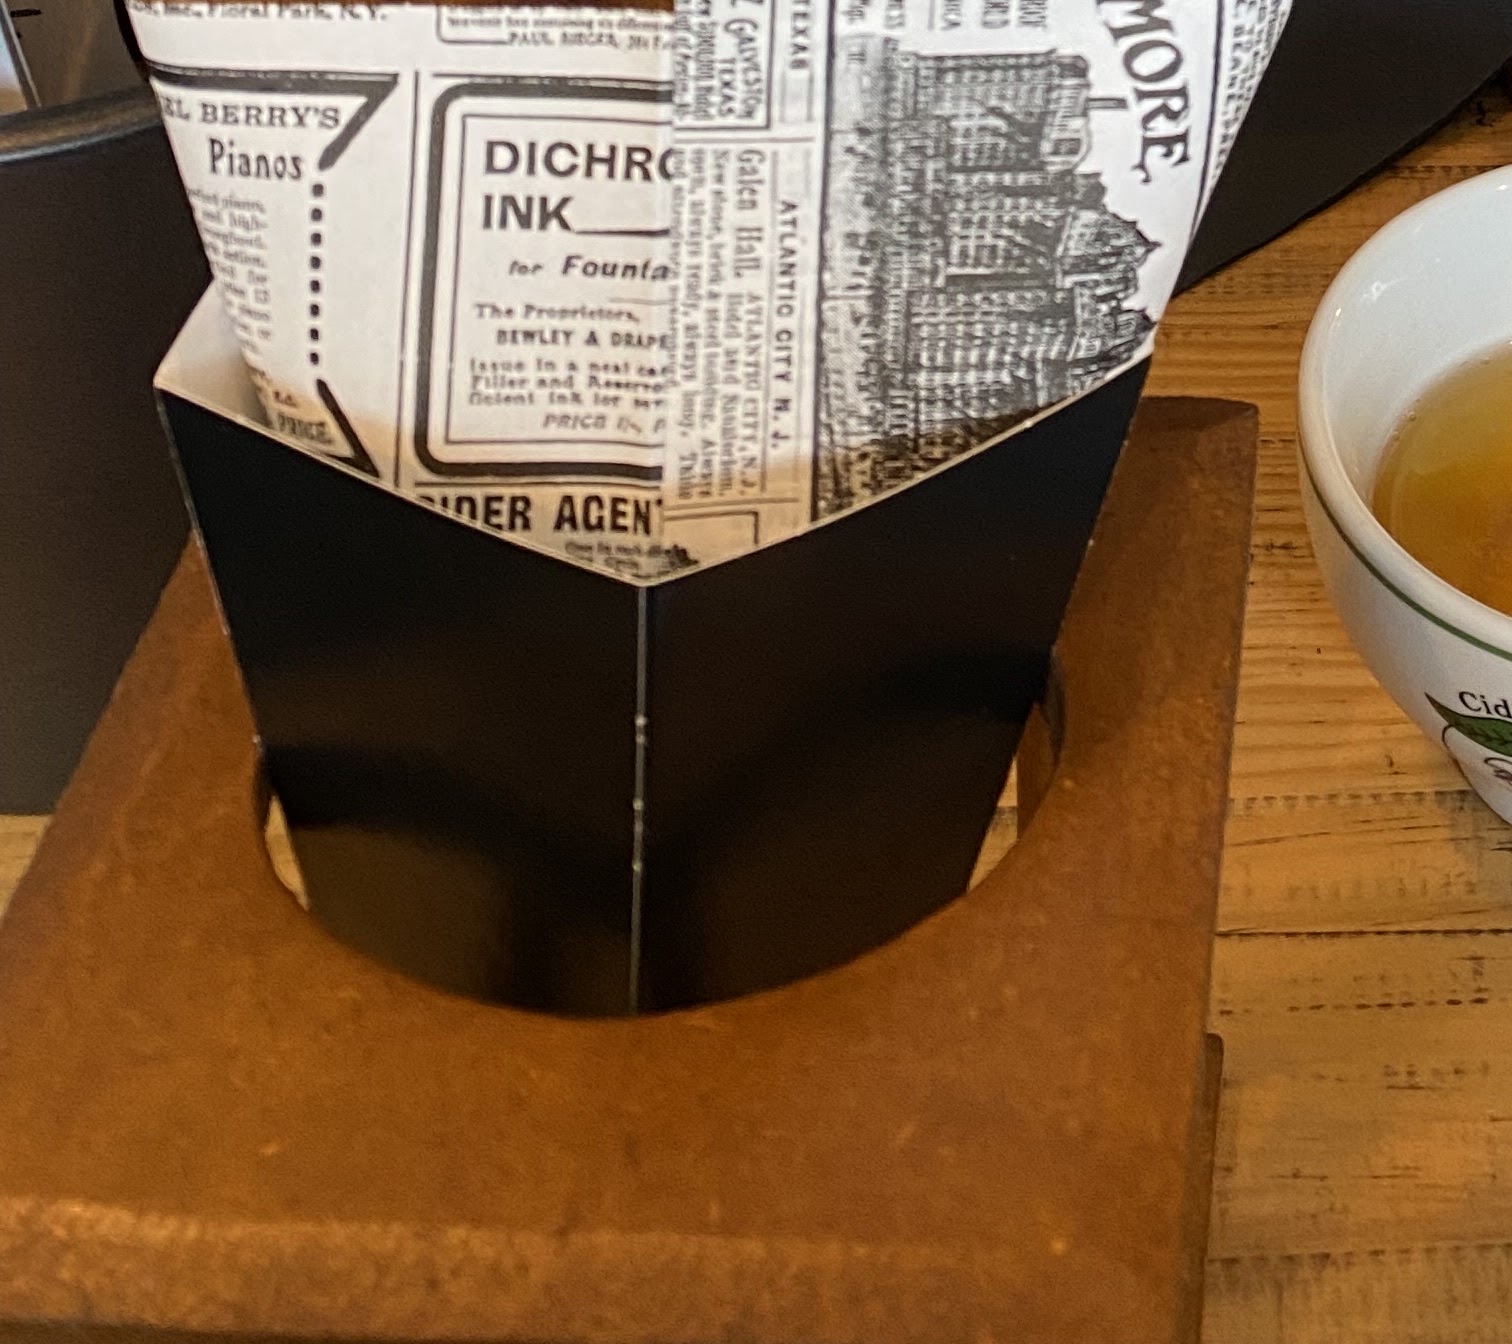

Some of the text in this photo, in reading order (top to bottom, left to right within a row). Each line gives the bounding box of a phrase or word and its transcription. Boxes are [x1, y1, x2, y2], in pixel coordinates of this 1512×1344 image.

[719, 56, 738, 117] TEXAS
[723, 18, 763, 119] GALVESTON
[201, 102, 340, 131] BERRY'S
[209, 137, 304, 180] Pianos
[483, 194, 574, 232] INK
[776, 200, 799, 318] ATLANTIC
[774, 330, 794, 383] CITY
[553, 494, 663, 536] AGEN
